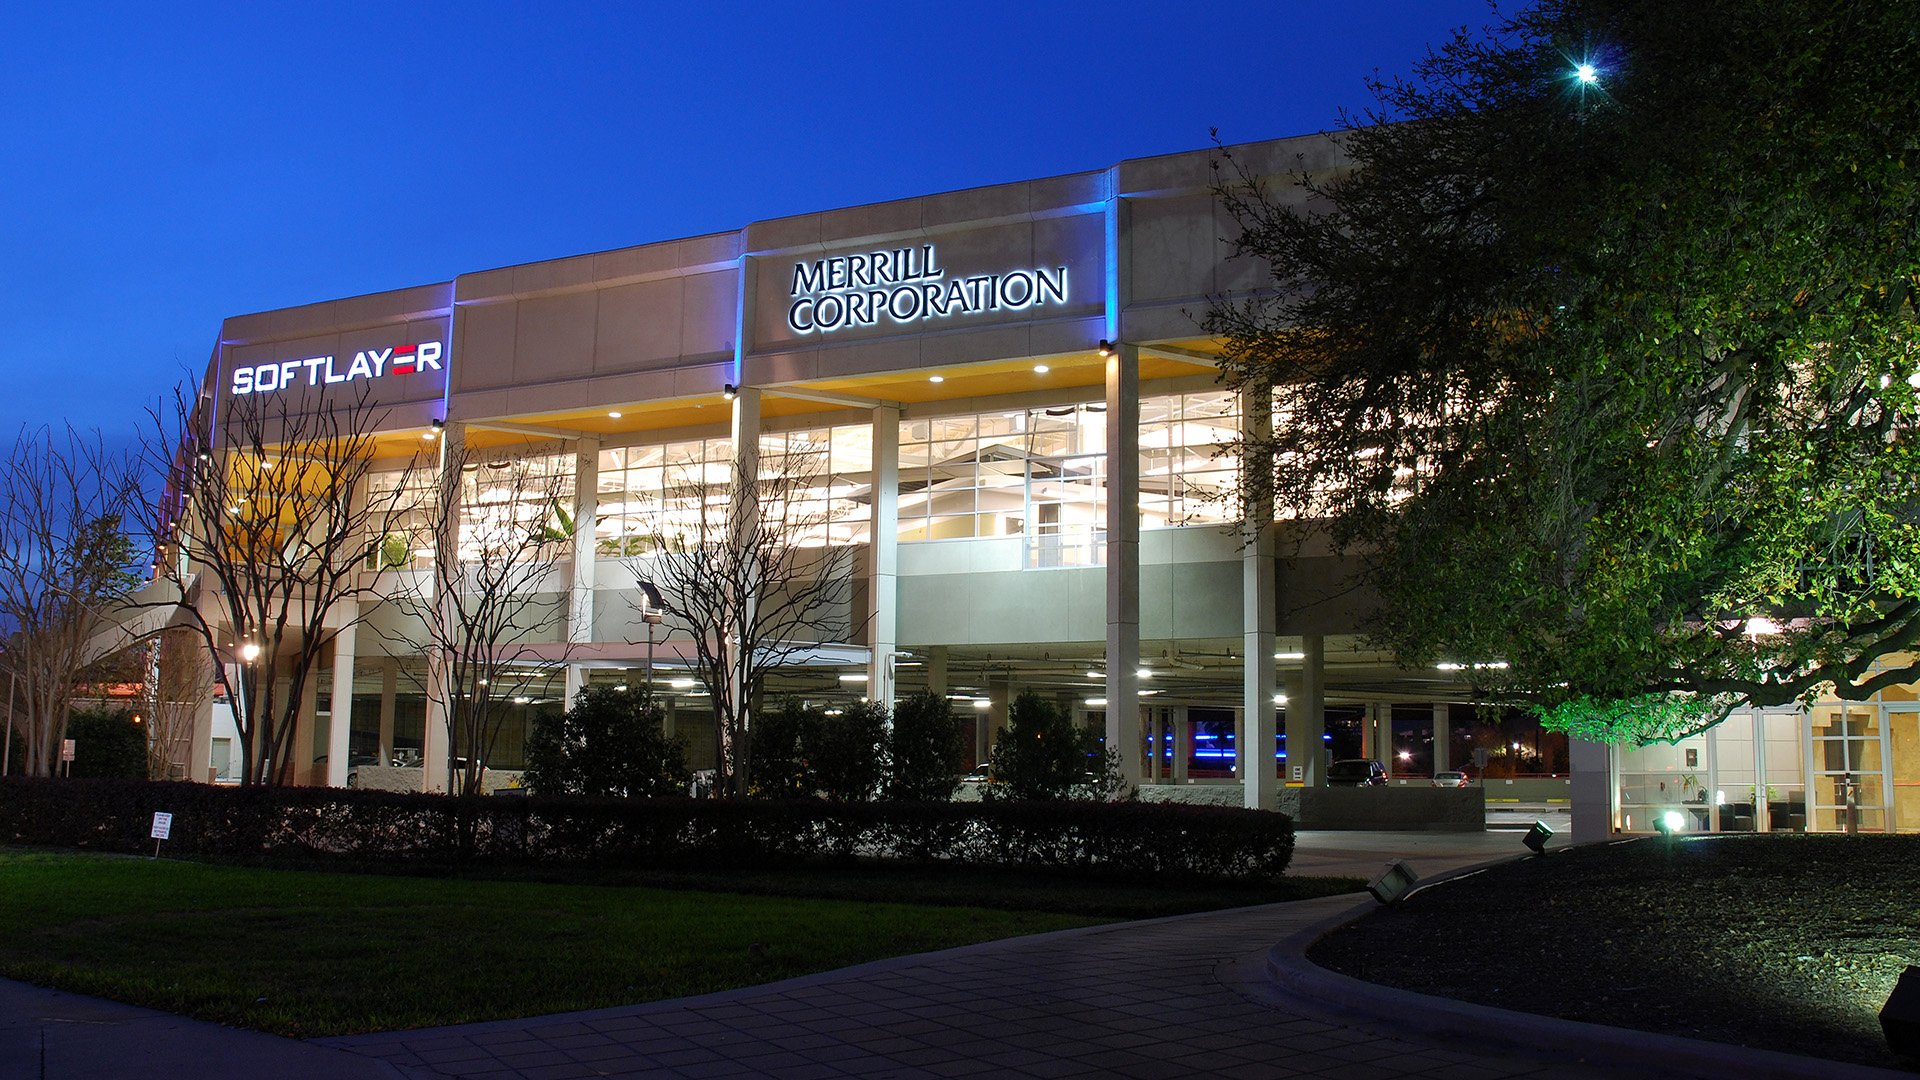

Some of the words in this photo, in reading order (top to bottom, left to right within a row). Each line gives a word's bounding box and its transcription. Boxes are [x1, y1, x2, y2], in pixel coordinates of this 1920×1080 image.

[790, 245, 943, 296] MERRILL
[788, 266, 1068, 331] CORPORATION
[232, 341, 443, 395] SOFTLAYER
